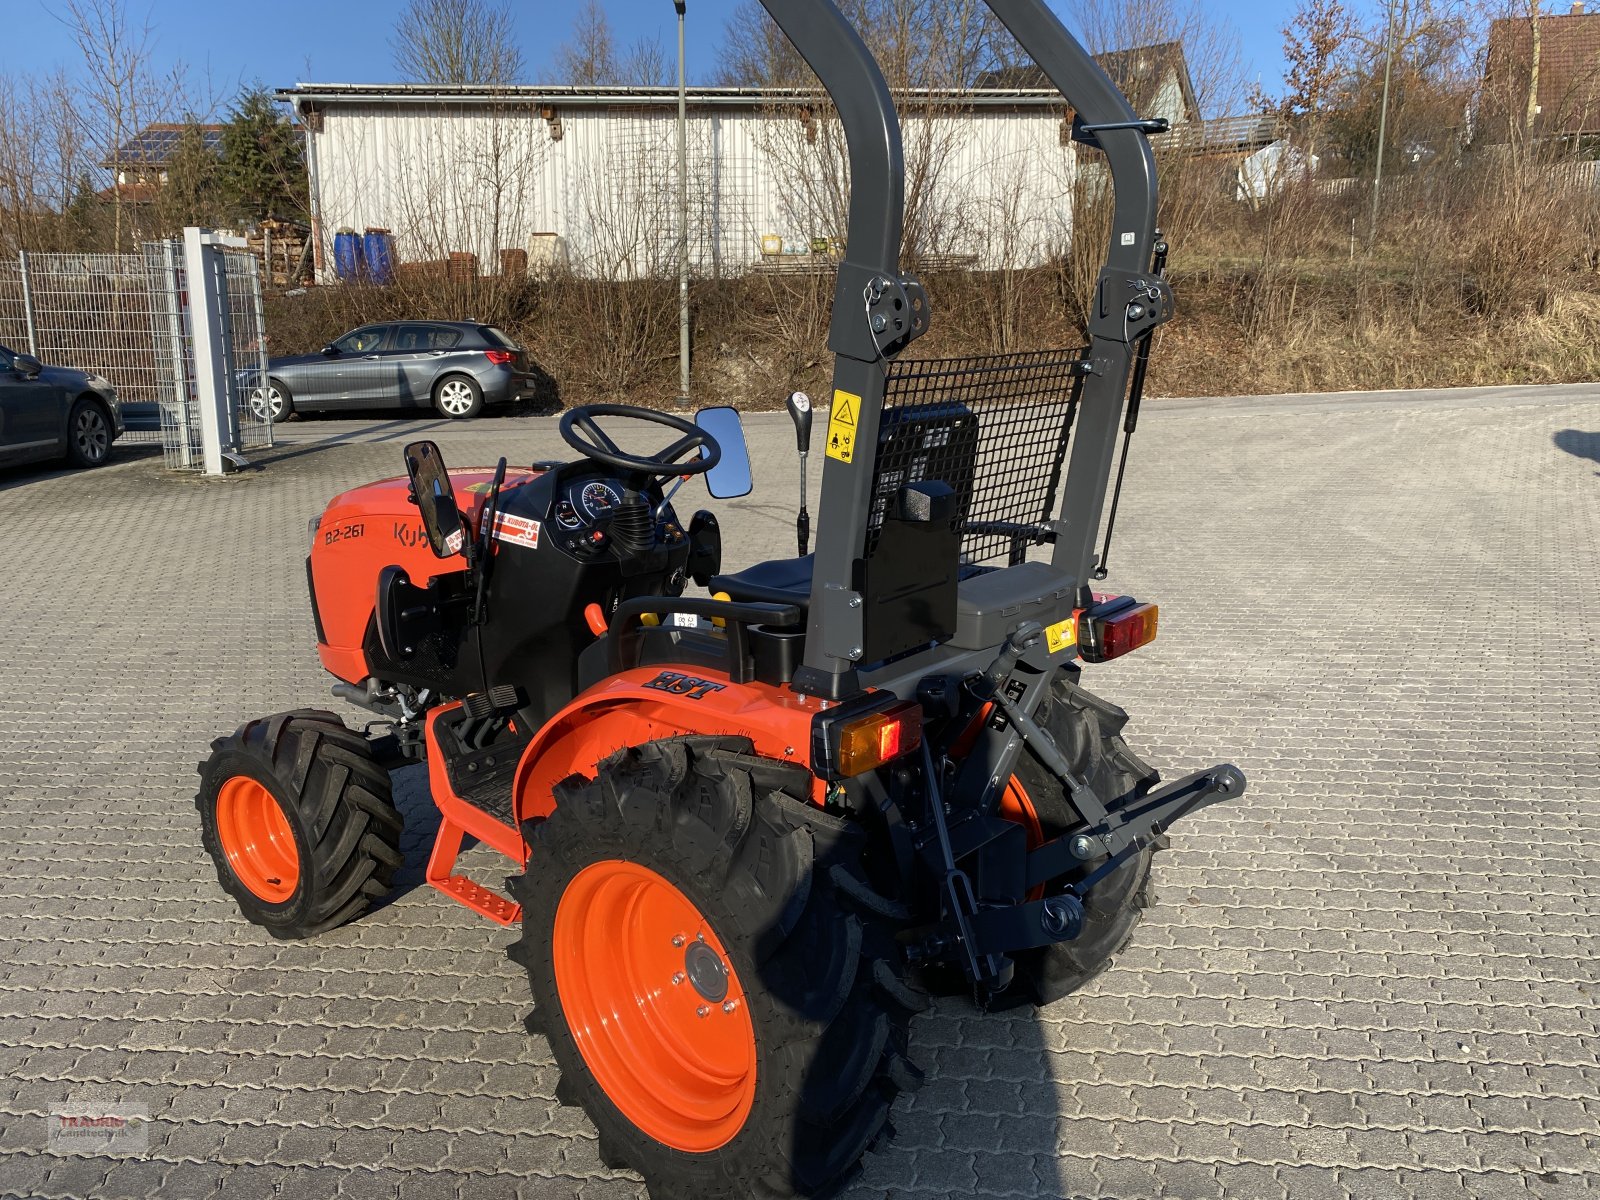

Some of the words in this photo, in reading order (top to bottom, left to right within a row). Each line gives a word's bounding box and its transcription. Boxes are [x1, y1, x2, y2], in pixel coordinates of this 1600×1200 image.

[325, 523, 365, 546] B2-261
[393, 522, 429, 549] Kub
[641, 671, 728, 700] HST
